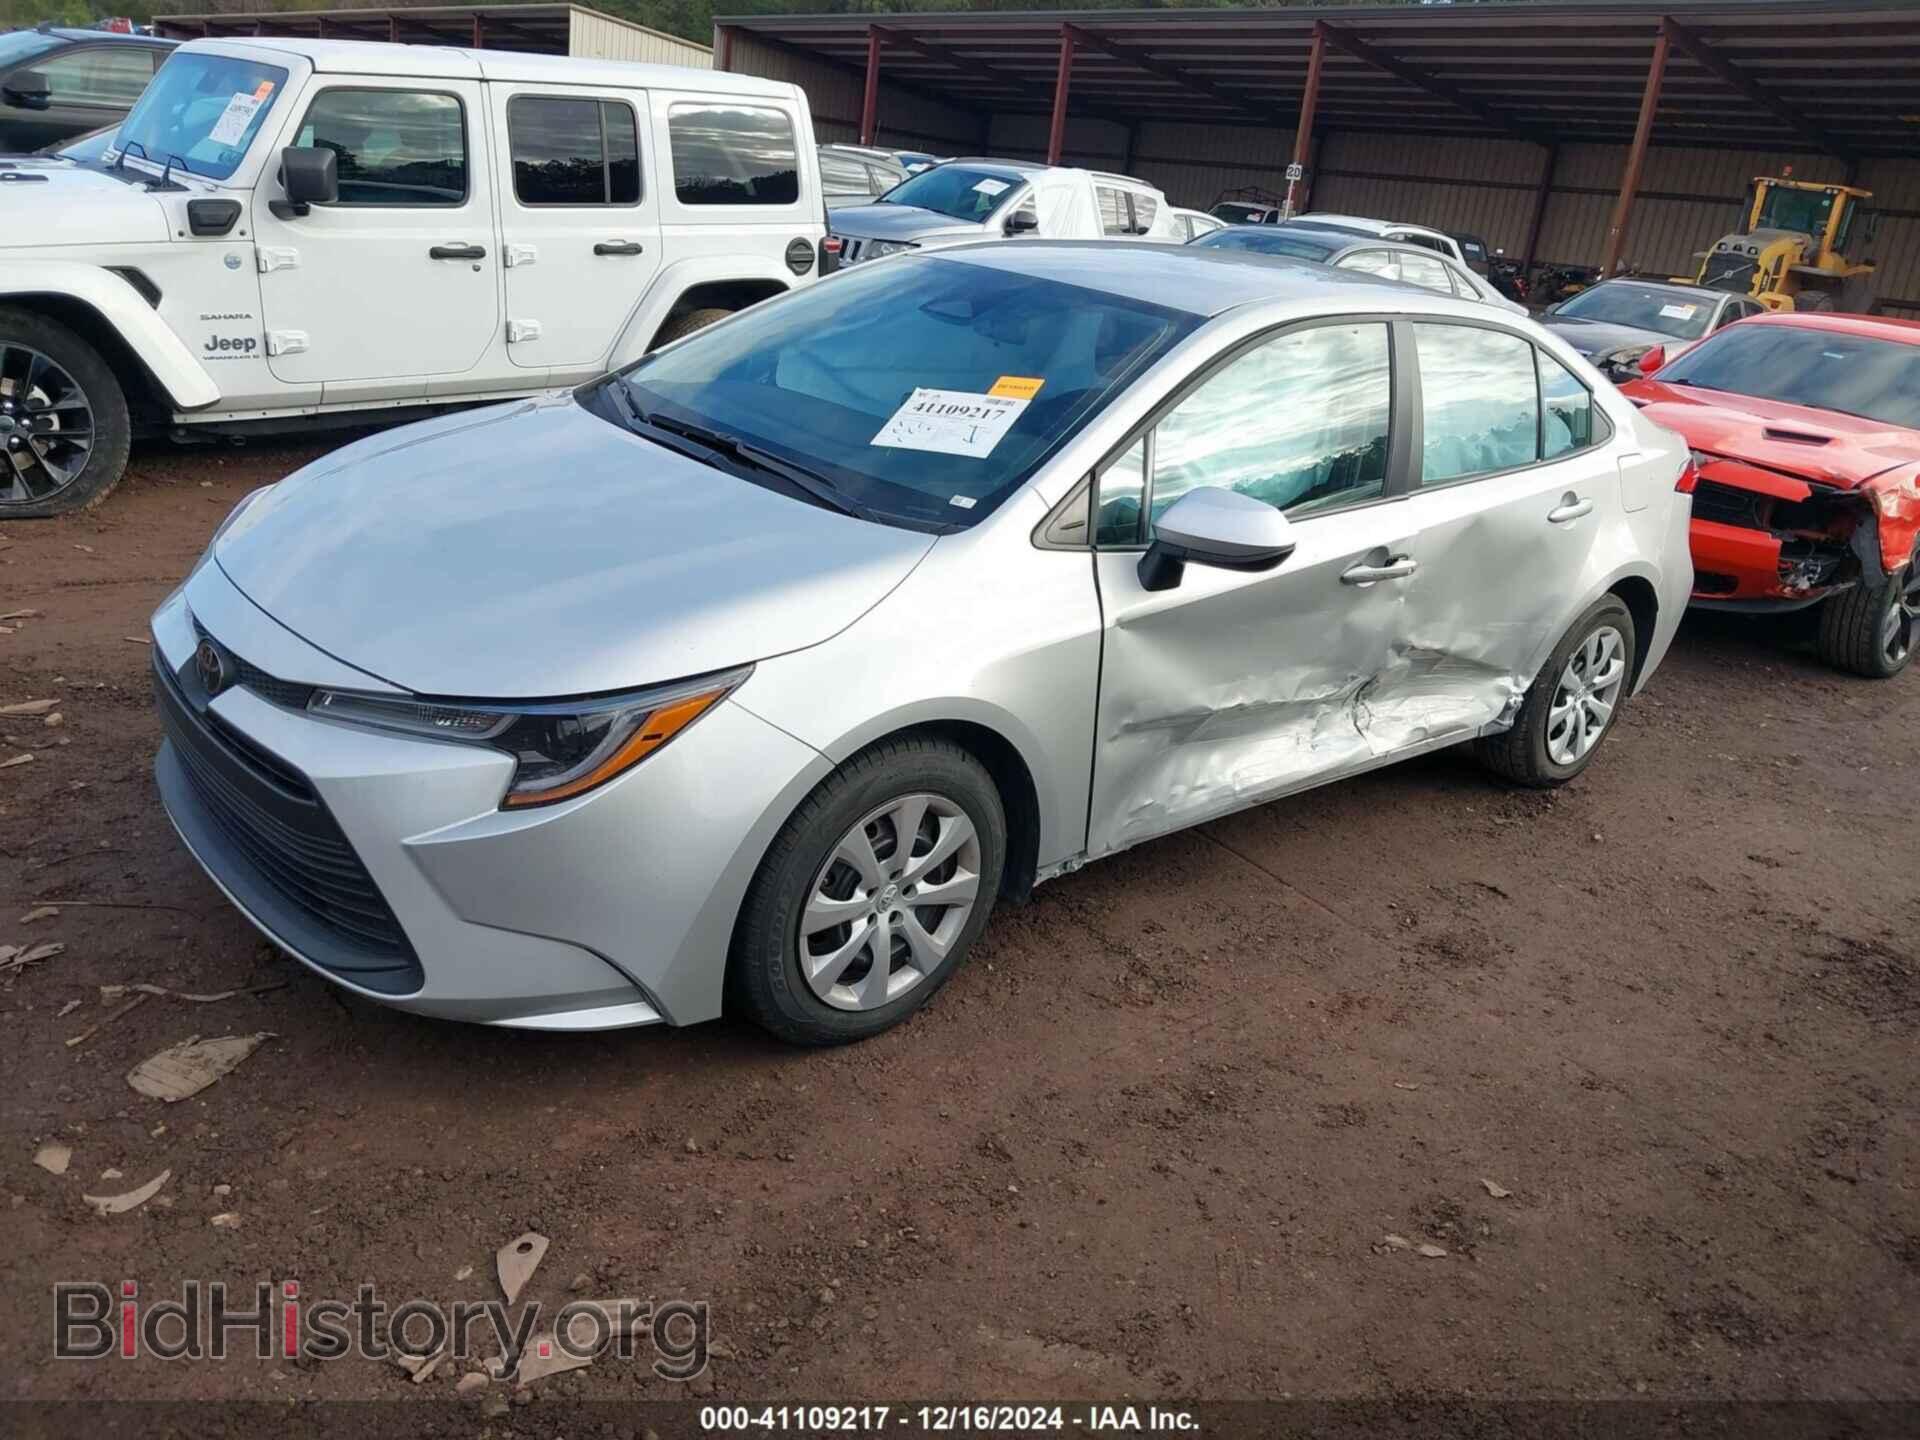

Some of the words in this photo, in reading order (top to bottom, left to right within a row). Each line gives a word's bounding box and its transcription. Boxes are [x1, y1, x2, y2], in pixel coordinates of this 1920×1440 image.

[1287, 166, 1301, 178] 20
[204, 335, 257, 353] Jeep
[913, 402, 1007, 420] 41109217
